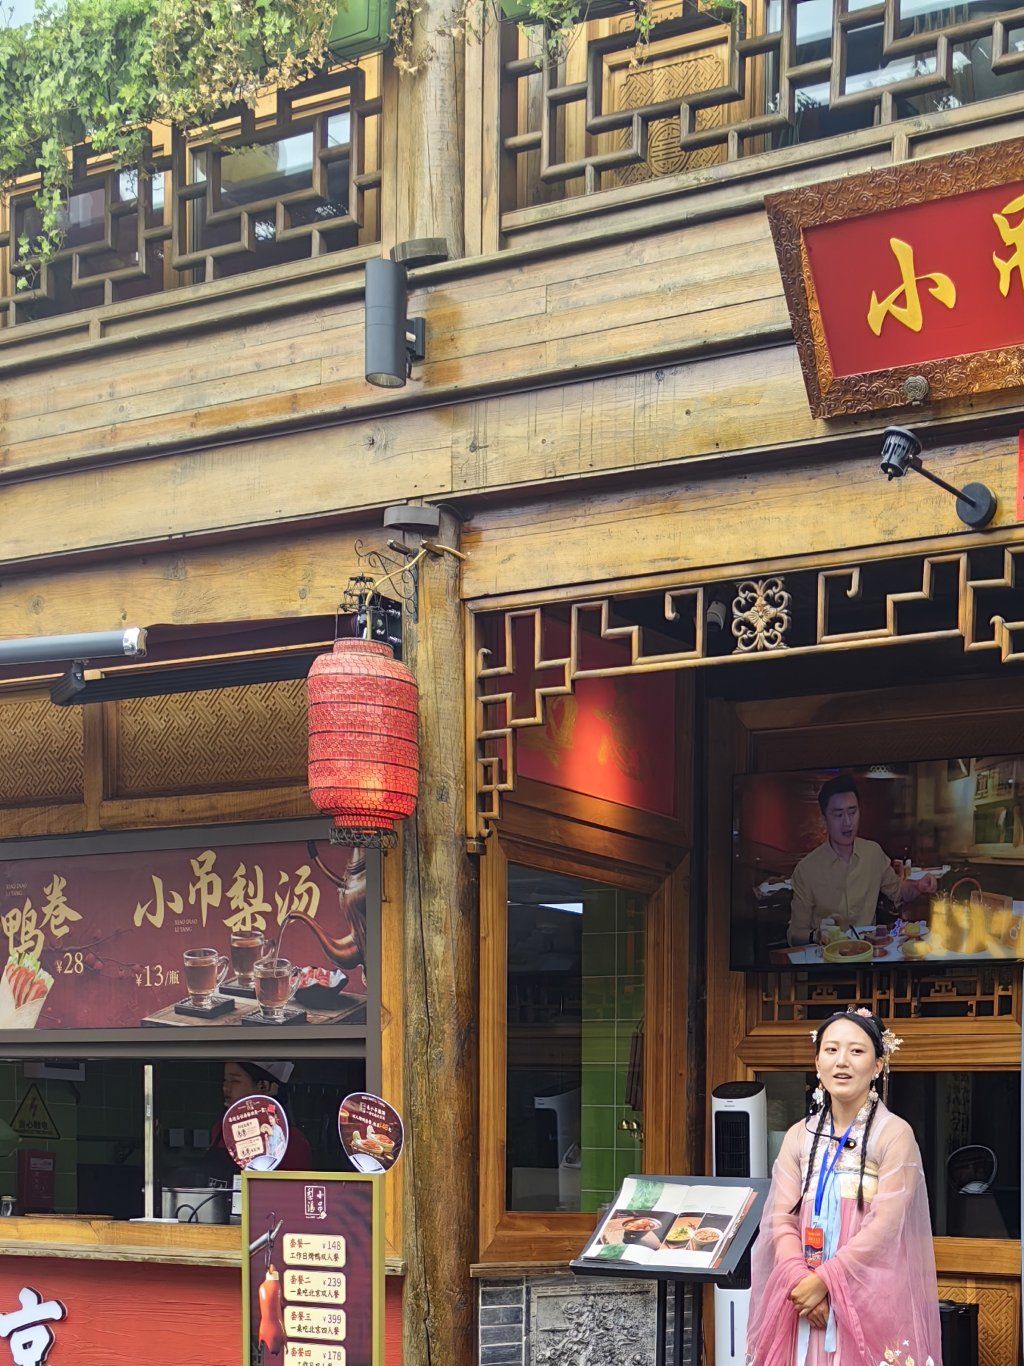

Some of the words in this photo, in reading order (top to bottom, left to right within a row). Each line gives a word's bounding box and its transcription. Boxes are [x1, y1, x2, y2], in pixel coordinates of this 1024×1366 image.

[133, 850, 321, 933] 小吊梨汤
[56, 952, 84, 974] ¥28
[290, 1274, 311, 1285] 套餐二
[323, 1277, 342, 1288] ¥239
[290, 1311, 312, 1321] 套餐三
[323, 1314, 342, 1325] ¥399
[290, 1347, 312, 1357] 套餐四
[323, 1351, 342, 1361] ¥178
